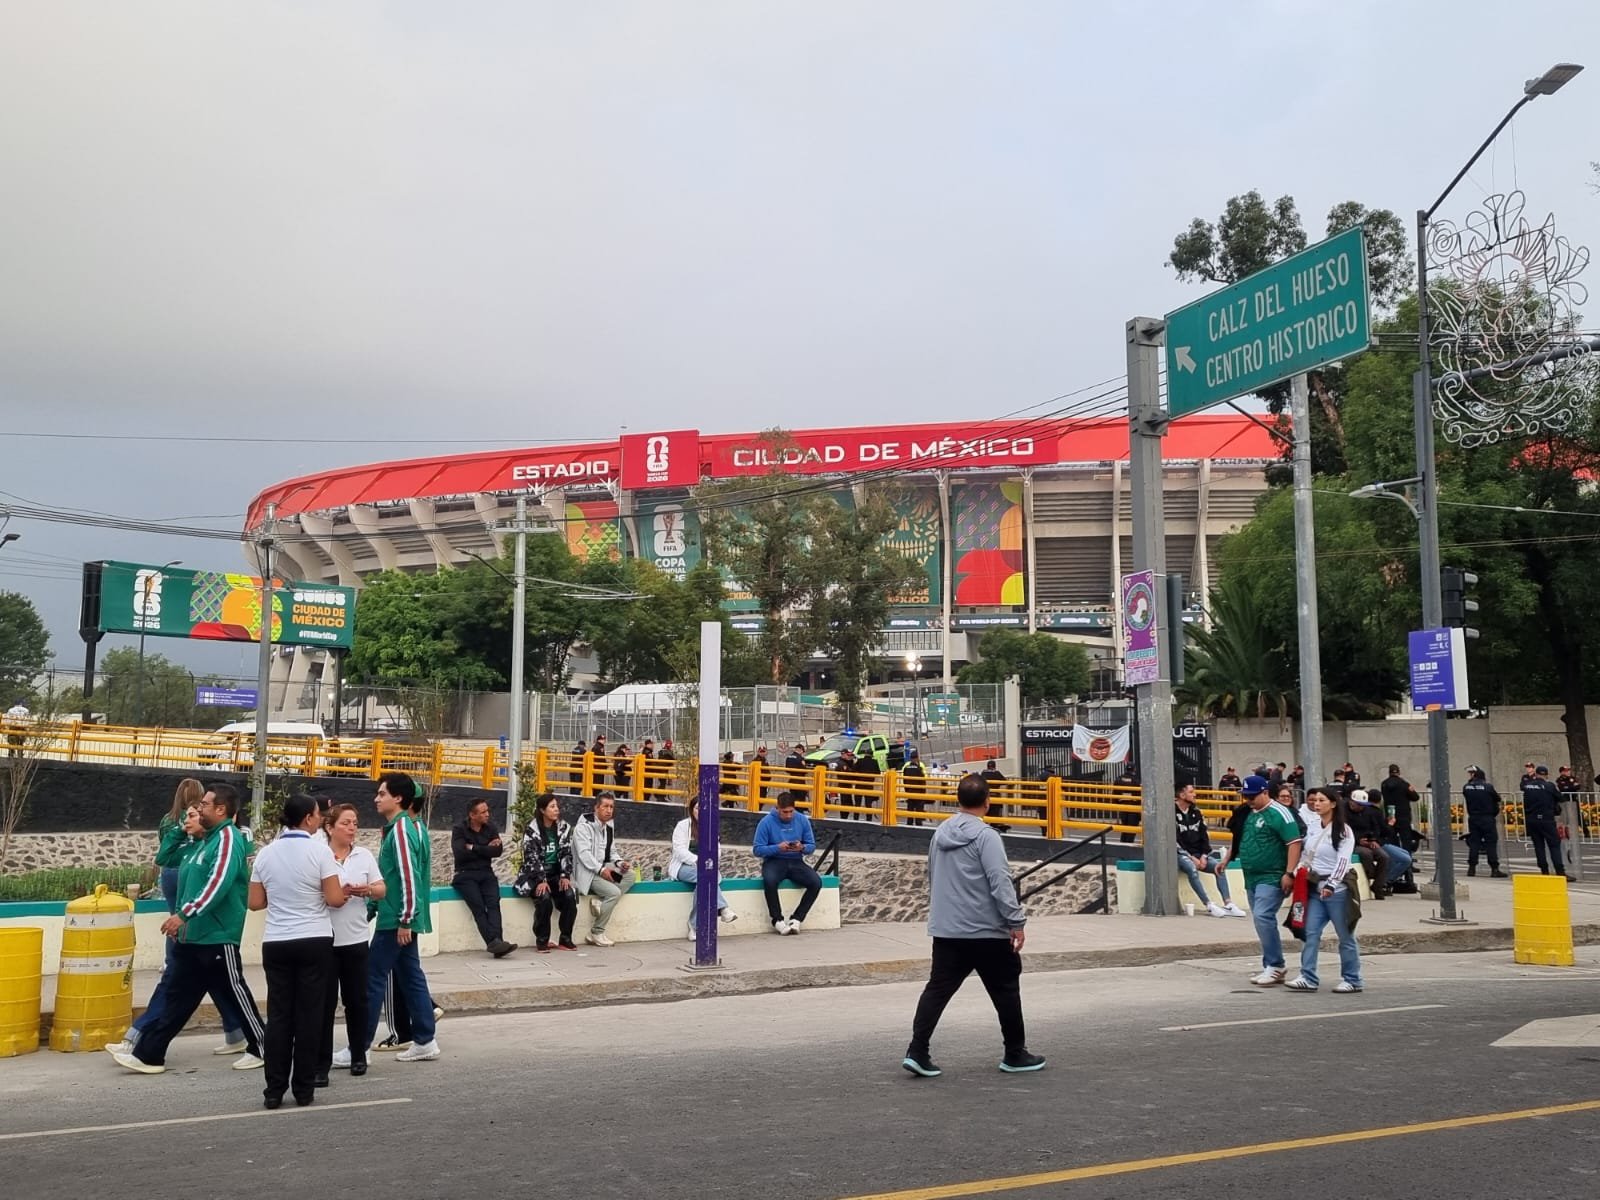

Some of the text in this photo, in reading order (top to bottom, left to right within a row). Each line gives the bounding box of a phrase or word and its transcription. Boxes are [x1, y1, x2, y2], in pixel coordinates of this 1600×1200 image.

[1208, 252, 1350, 342] CALZ DEL HUESO
[1206, 300, 1358, 388] CENTRO HISTORICO
[512, 436, 1036, 481] ESTADIO CIUDAD DE MÉXICO
[654, 557, 687, 568] COPA
[292, 604, 345, 618] CIUDAD DE
[292, 614, 345, 628] MÉXICO
